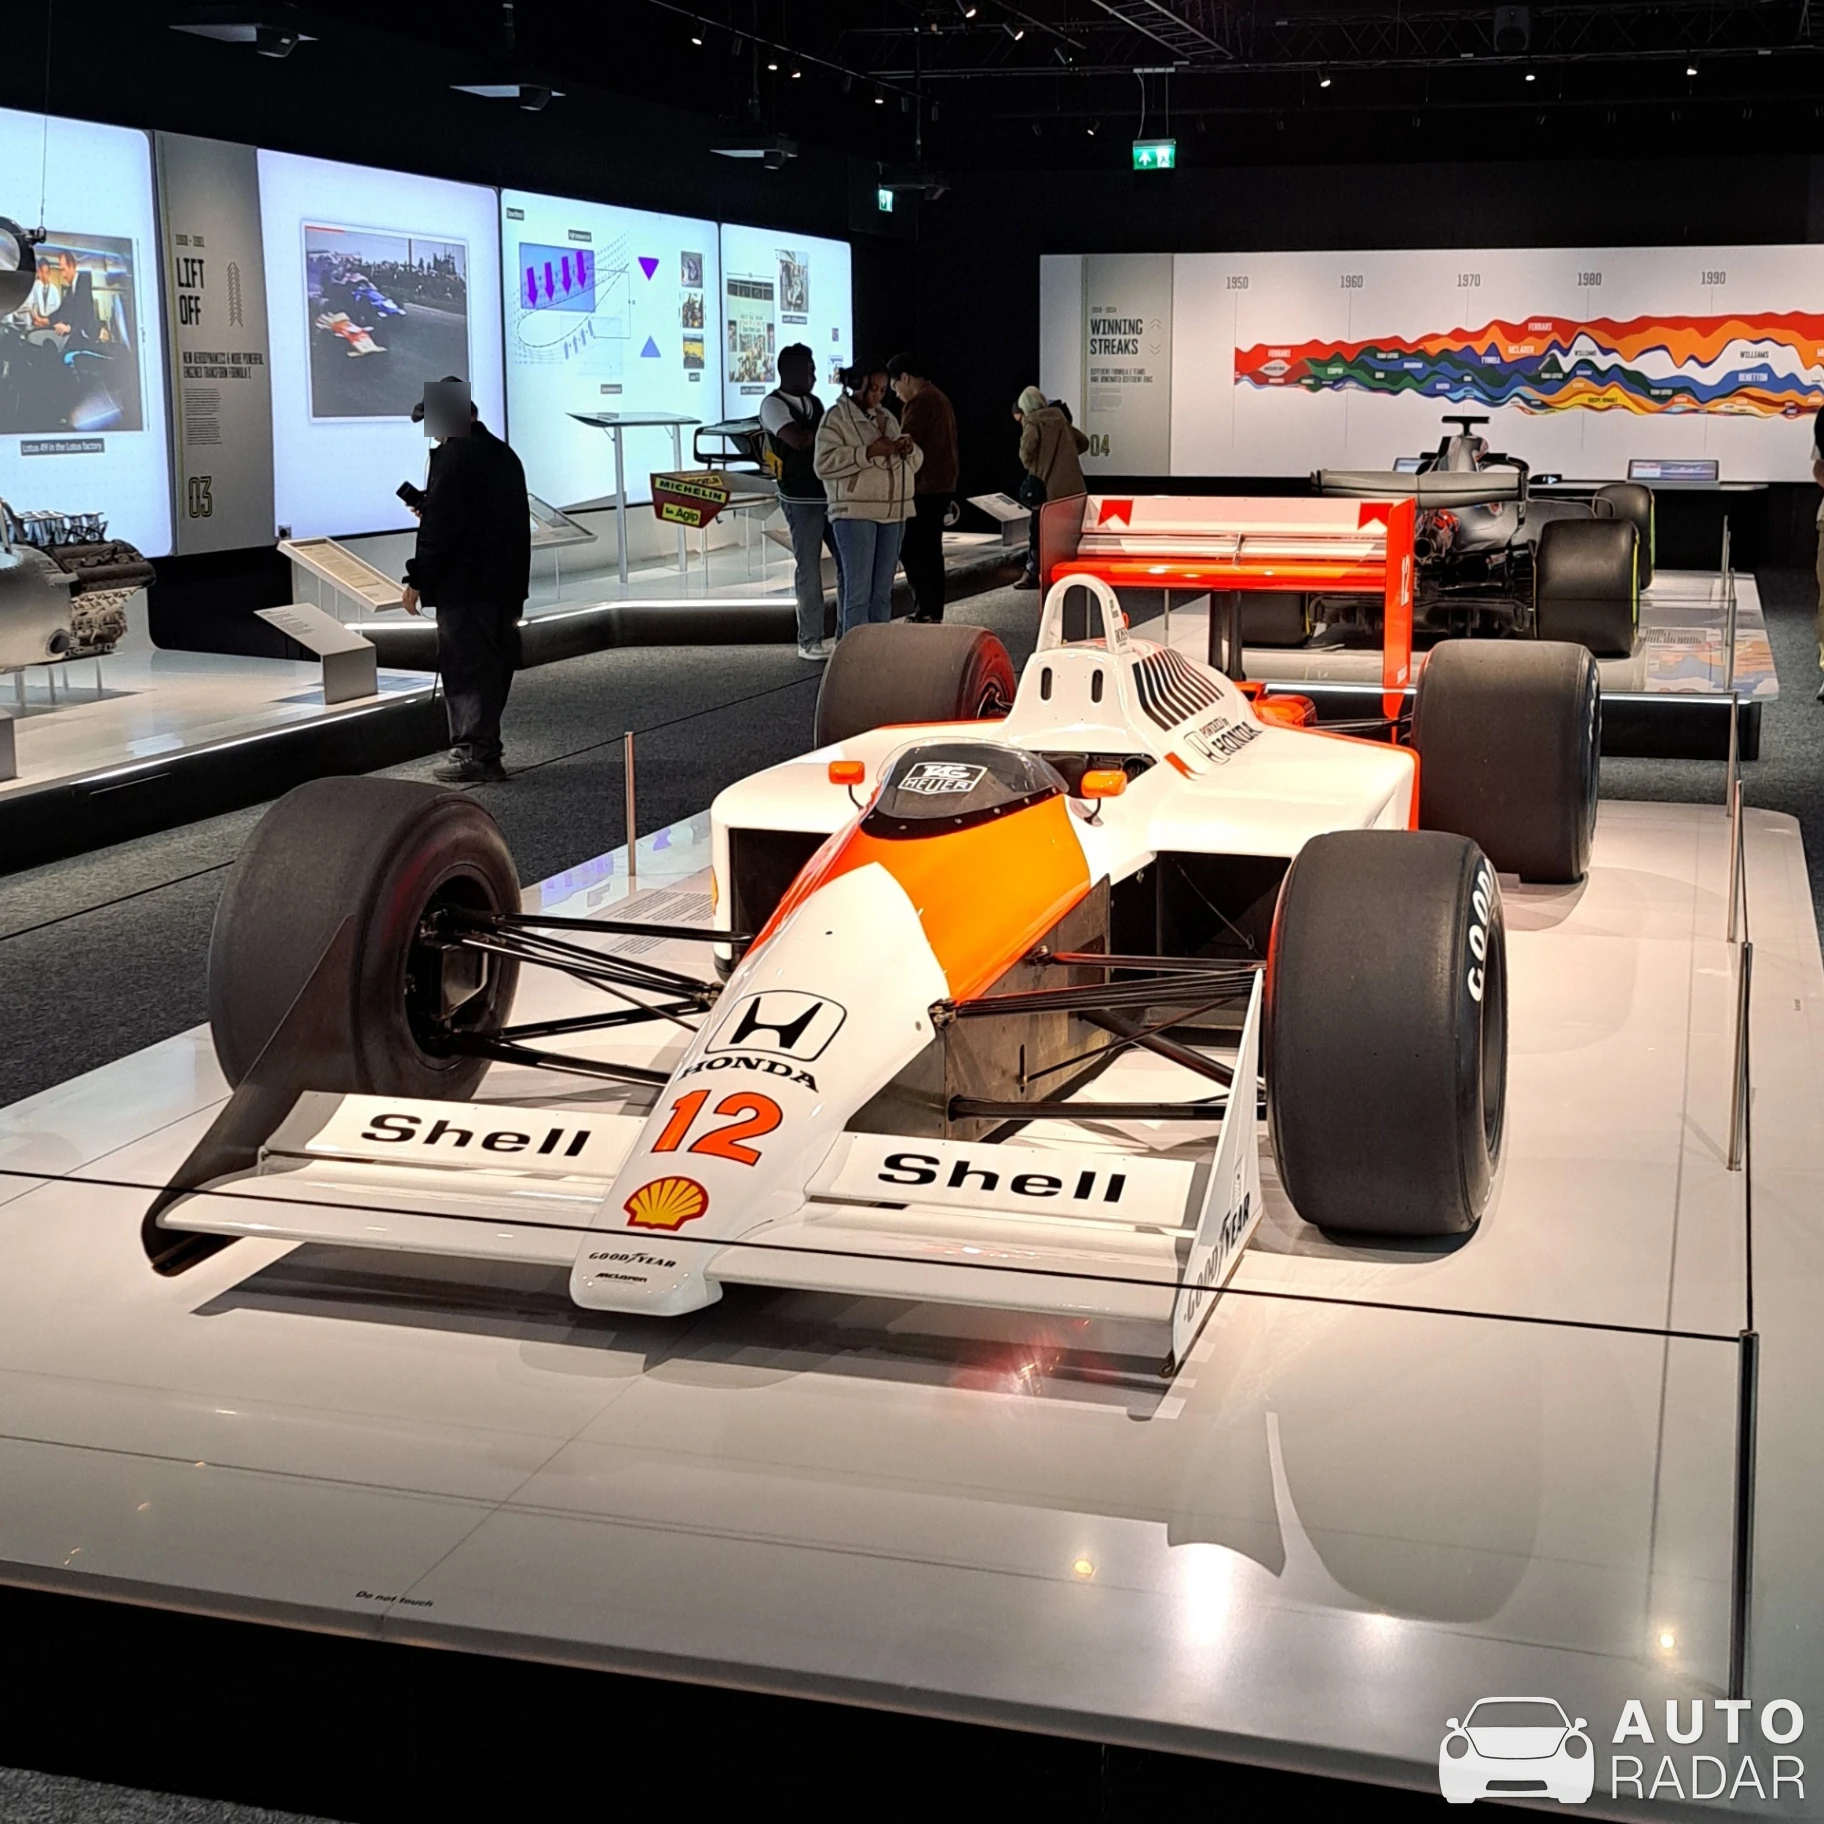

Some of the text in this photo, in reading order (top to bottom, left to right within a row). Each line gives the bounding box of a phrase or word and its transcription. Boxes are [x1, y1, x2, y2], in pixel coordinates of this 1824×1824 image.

[176, 257, 204, 289] LIFT
[1340, 275, 1364, 288] 1960
[1457, 274, 1481, 287] 1970
[1577, 272, 1602, 286] 1980
[1701, 271, 1726, 285] 1990
[1226, 276, 1249, 289] 1950
[179, 294, 201, 325] OFF
[1090, 319, 1143, 335] WINNING
[1528, 322, 1552, 331] FERRARI
[1090, 338, 1138, 355] STREAKS
[1740, 350, 1769, 359] WILLIAMS
[1090, 434, 1110, 457] 04
[189, 476, 212, 518] 03
[660, 480, 722, 500] MICHELIN
[676, 508, 699, 522] Agip
[1211, 721, 1263, 755] HONDA
[904, 779, 968, 791] HEUER
[677, 1056, 819, 1093] HONDA
[361, 1113, 591, 1156] Shell
[650, 1089, 783, 1167] 12
[878, 1153, 1126, 1203] Shell
[356, 1590, 373, 1599] Do
[399, 1597, 433, 1607] touch
